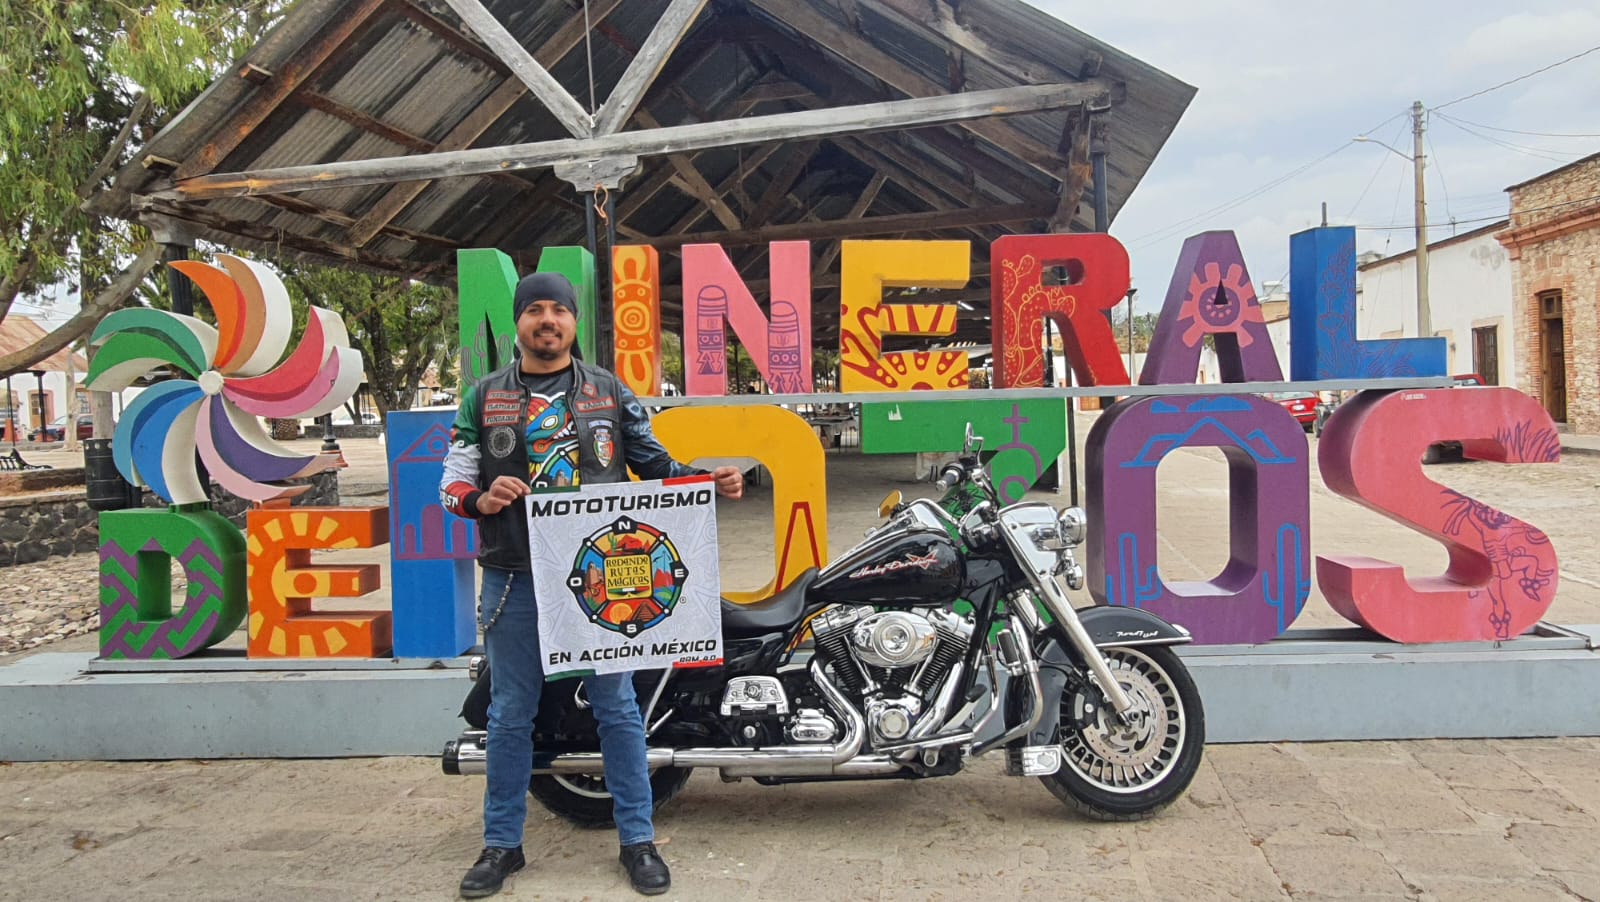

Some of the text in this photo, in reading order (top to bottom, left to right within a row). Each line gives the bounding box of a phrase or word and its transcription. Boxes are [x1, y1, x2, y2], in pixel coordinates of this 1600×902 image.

[457, 226, 1447, 399] MINERAL
[531, 490, 711, 518] MOTOTURISMO
[618, 521, 631, 530] N
[610, 566, 646, 577] RUTAS
[674, 568, 685, 578] E
[99, 508, 391, 659] DE
[626, 624, 637, 633] S
[549, 639, 717, 665] EN ACCIÓN MÉXICO
